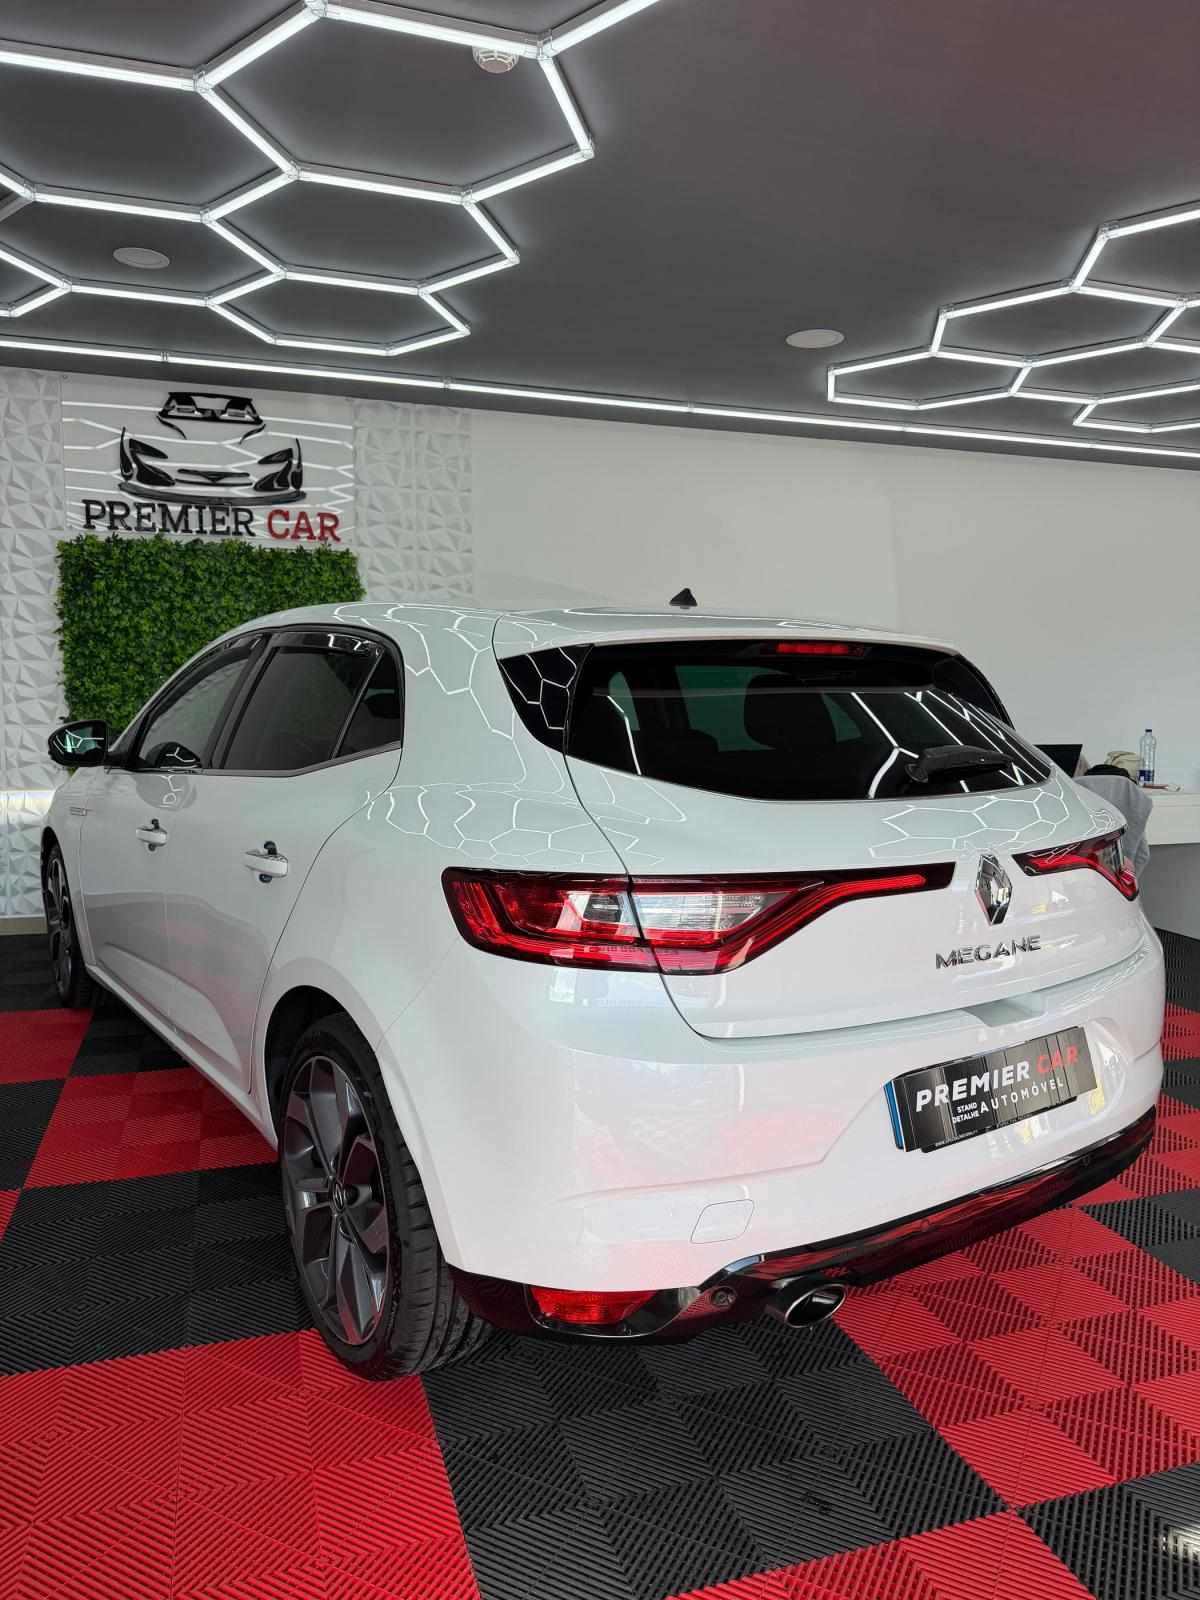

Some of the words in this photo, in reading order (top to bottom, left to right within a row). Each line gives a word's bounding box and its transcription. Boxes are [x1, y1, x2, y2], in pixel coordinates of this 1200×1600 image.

[83, 500, 256, 537] PREMIER
[266, 509, 341, 542] CAR
[936, 936, 1041, 970] MEGANE
[916, 1060, 1030, 1112] PREMIER
[1037, 1045, 1079, 1073] CAR
[980, 1077, 1064, 1113] AUTOMÓVEL
[952, 1111, 980, 1124] DETALHE
[957, 1102, 978, 1113] STAND
